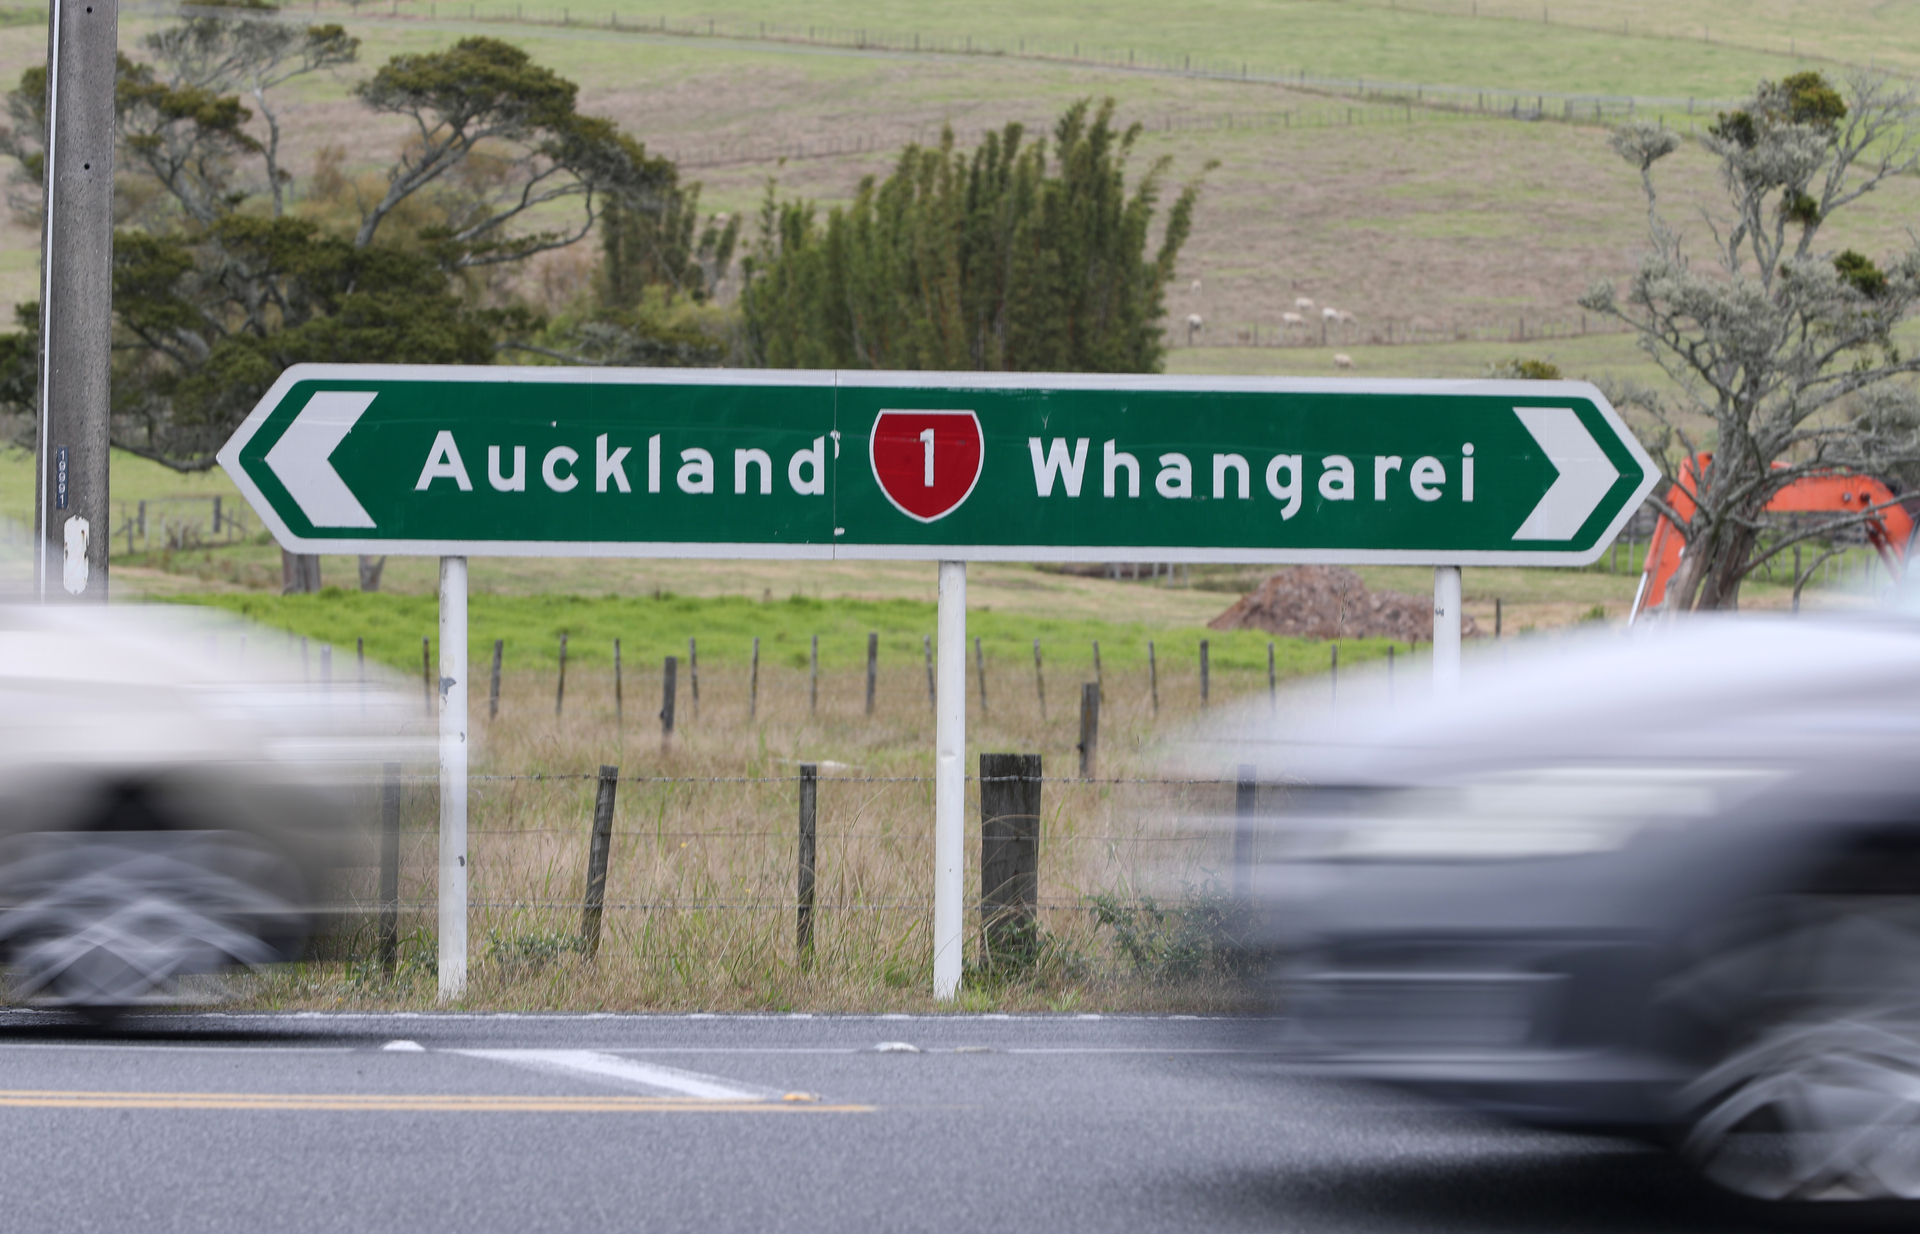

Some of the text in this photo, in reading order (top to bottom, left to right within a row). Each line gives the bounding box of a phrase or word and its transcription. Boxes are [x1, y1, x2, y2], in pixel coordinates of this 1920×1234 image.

[58, 449, 67, 505] 19991
[414, 430, 825, 496] Auckland
[919, 428, 935, 488] 1
[1028, 436, 1476, 521] Whangarei
